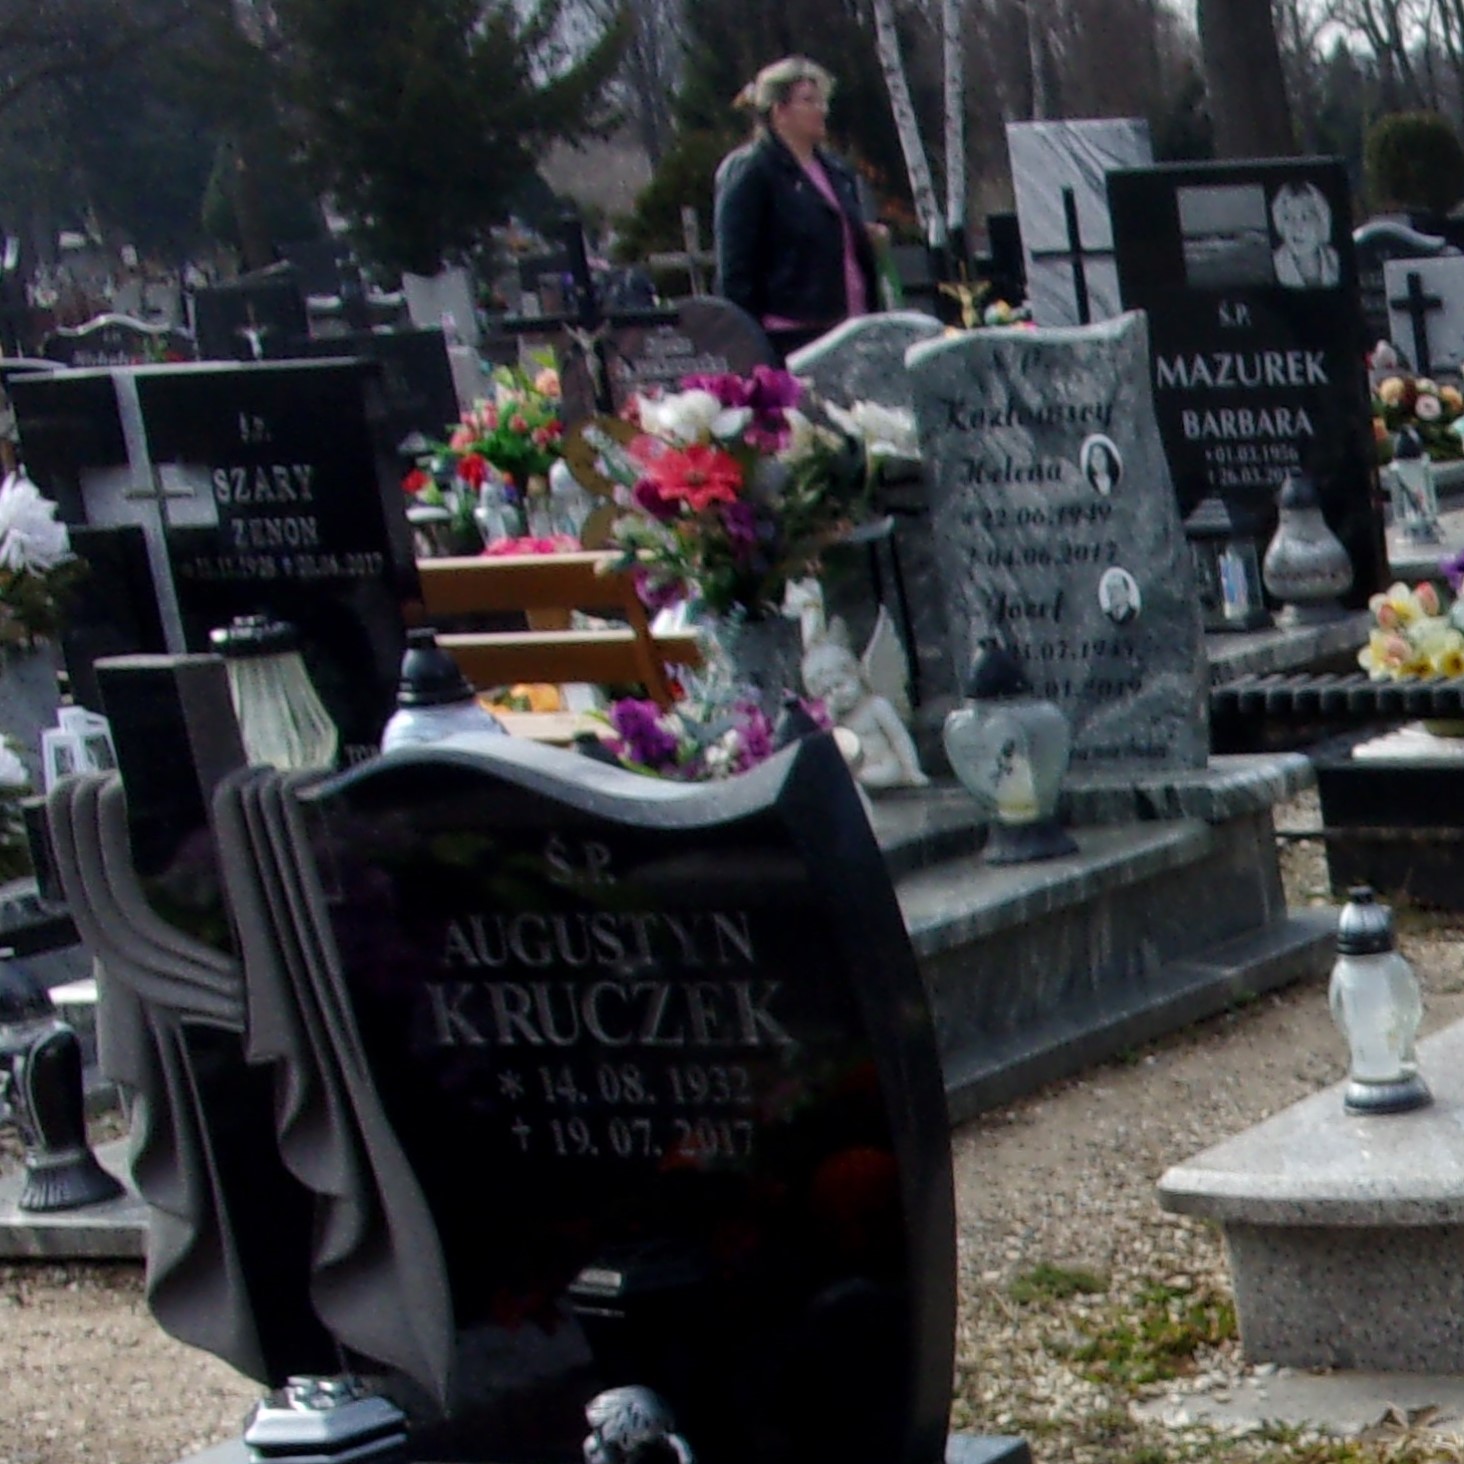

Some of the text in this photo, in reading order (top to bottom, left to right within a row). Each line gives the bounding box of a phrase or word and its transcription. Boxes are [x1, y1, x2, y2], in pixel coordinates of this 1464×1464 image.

[1156, 350, 1330, 388] MAZUREK
[1182, 406, 1315, 440] BARBARA
[213, 463, 314, 505] SZARY
[231, 515, 319, 548] ZENON
[442, 911, 756, 967] AUGUSTYN
[425, 980, 795, 1047] KRUCZEK
